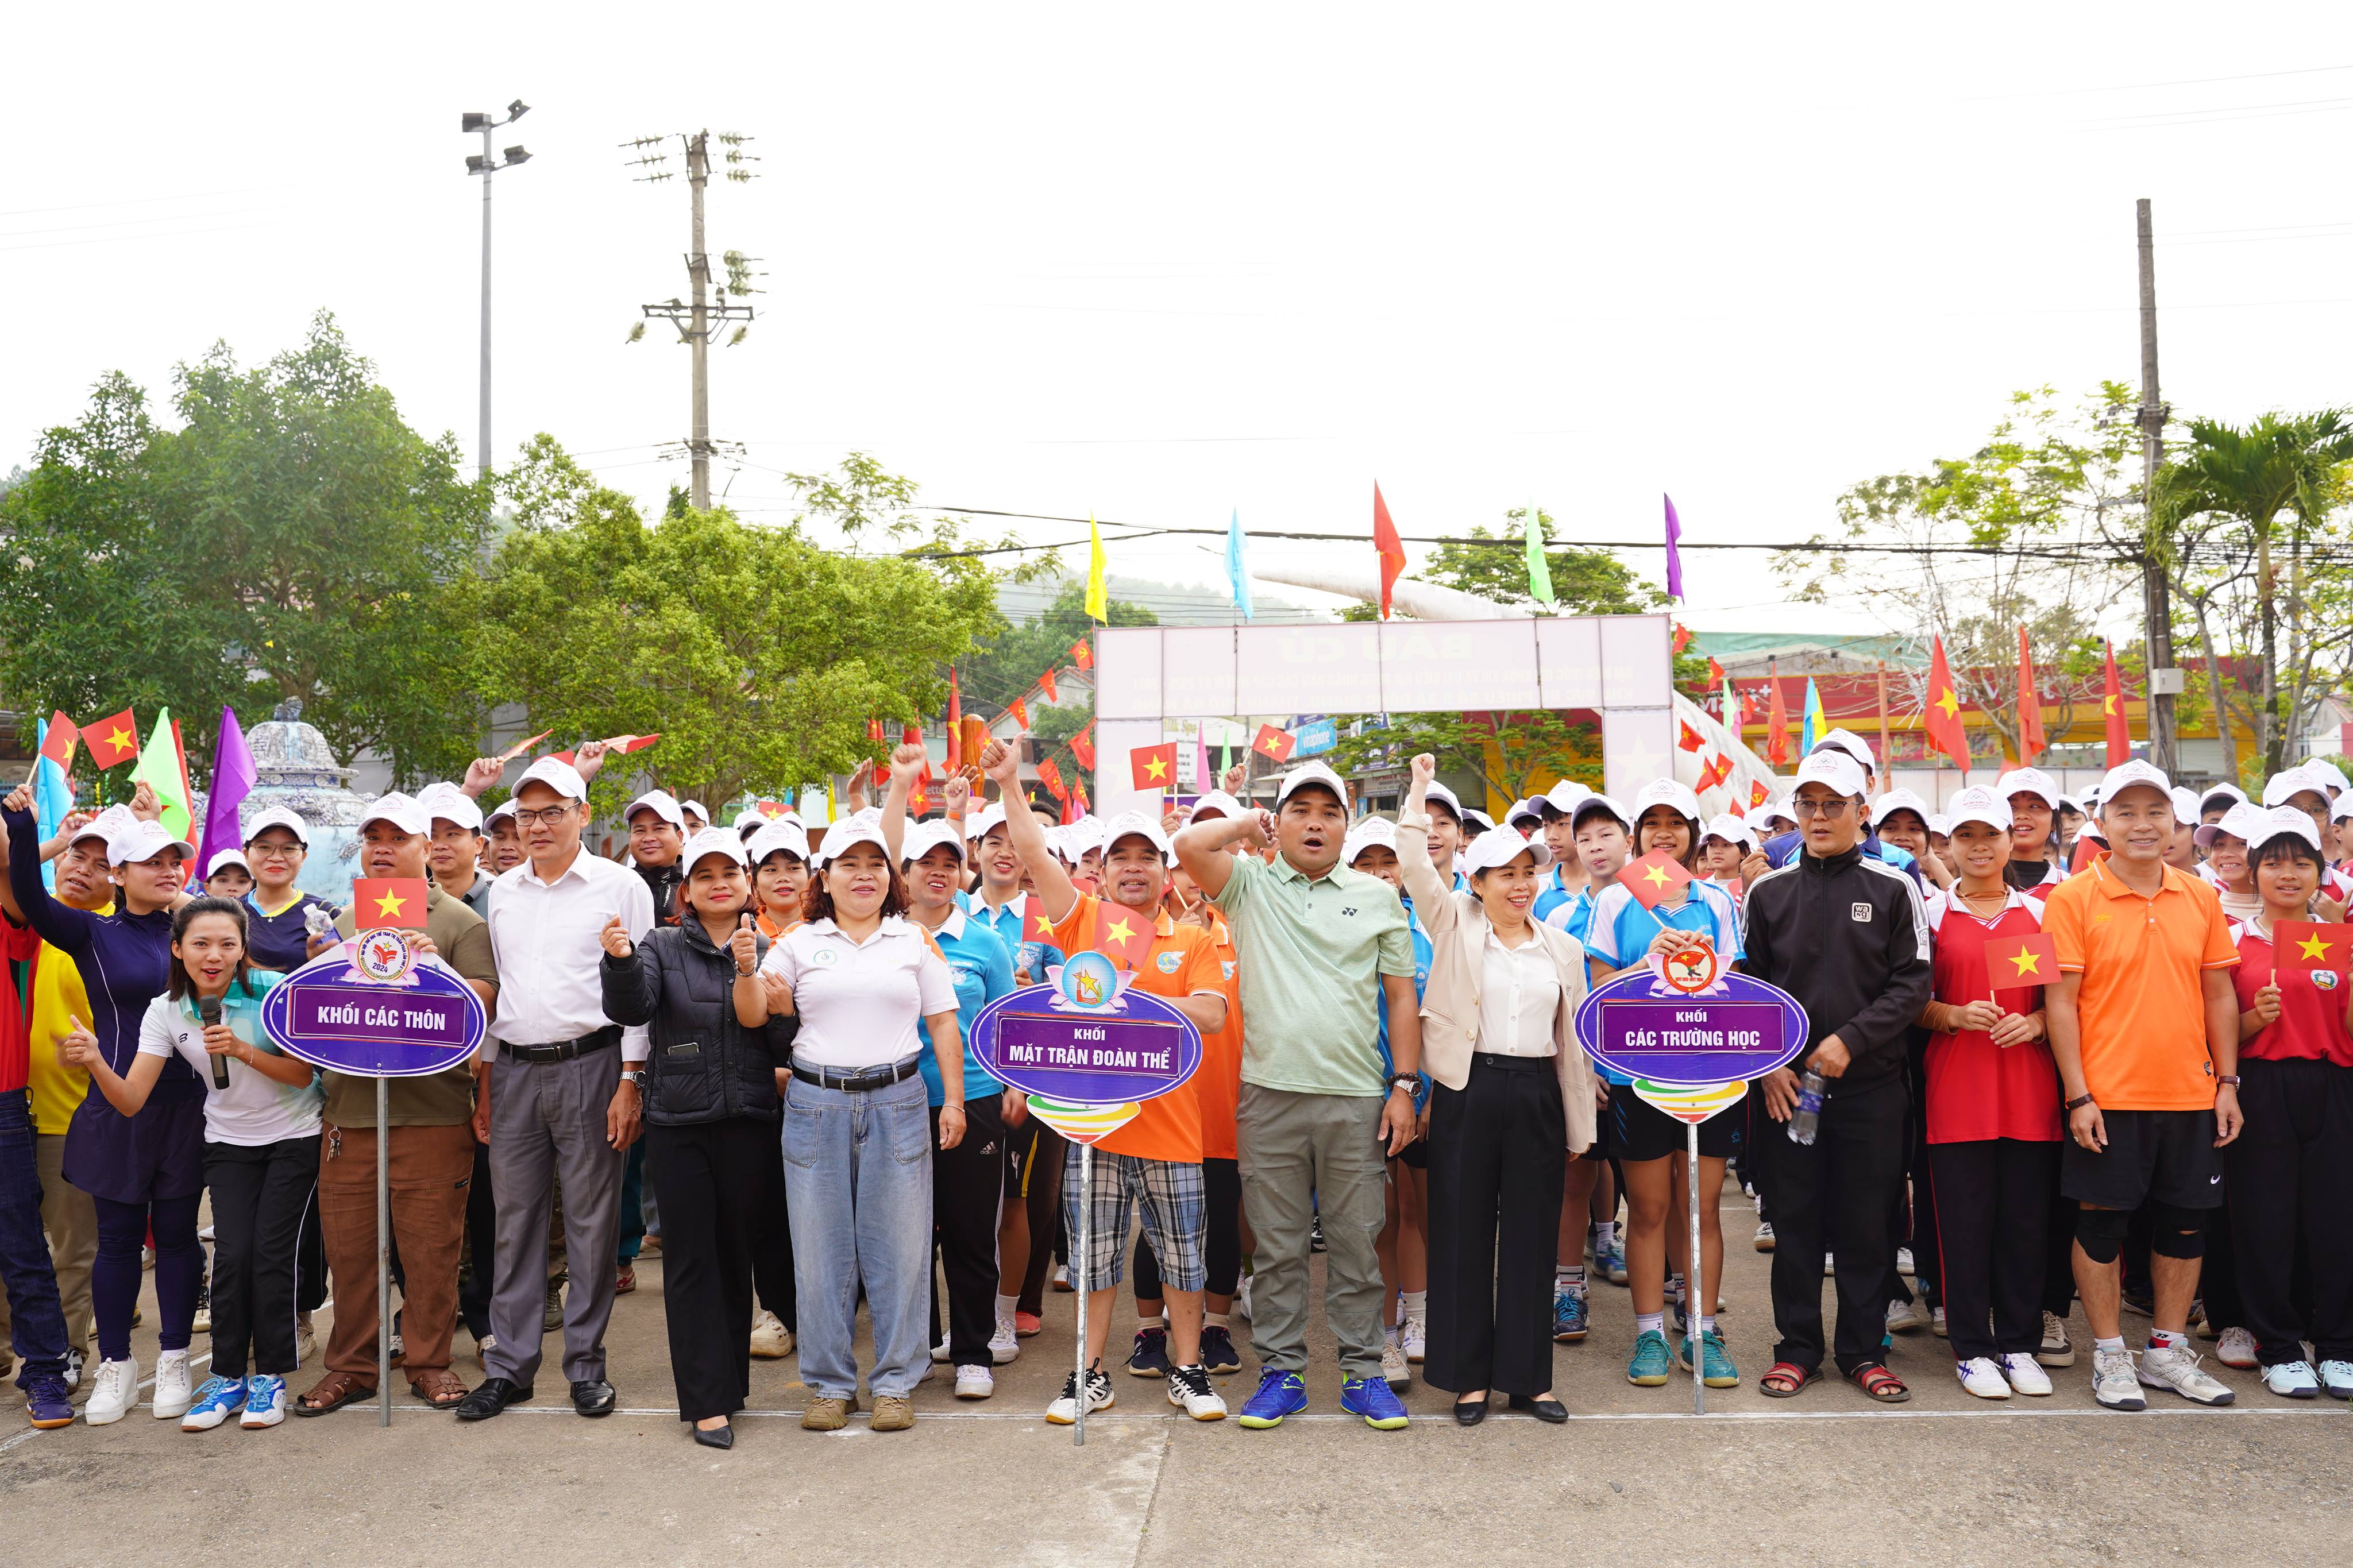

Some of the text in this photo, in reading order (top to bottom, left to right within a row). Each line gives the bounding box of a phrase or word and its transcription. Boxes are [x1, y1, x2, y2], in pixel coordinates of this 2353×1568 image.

[1303, 729, 1330, 749] vinaphone
[372, 962, 388, 973] 2024
[318, 1001, 445, 1030] KHỐI CÁC THÔN
[1676, 1007, 1707, 1022] KHỐI
[1074, 1025, 1105, 1041] KHỐI
[1625, 1027, 1760, 1049] CÁC TRƯỜNG HỌC
[1009, 1043, 1171, 1069] MẶT TRẬN ĐOÀN THỂ
